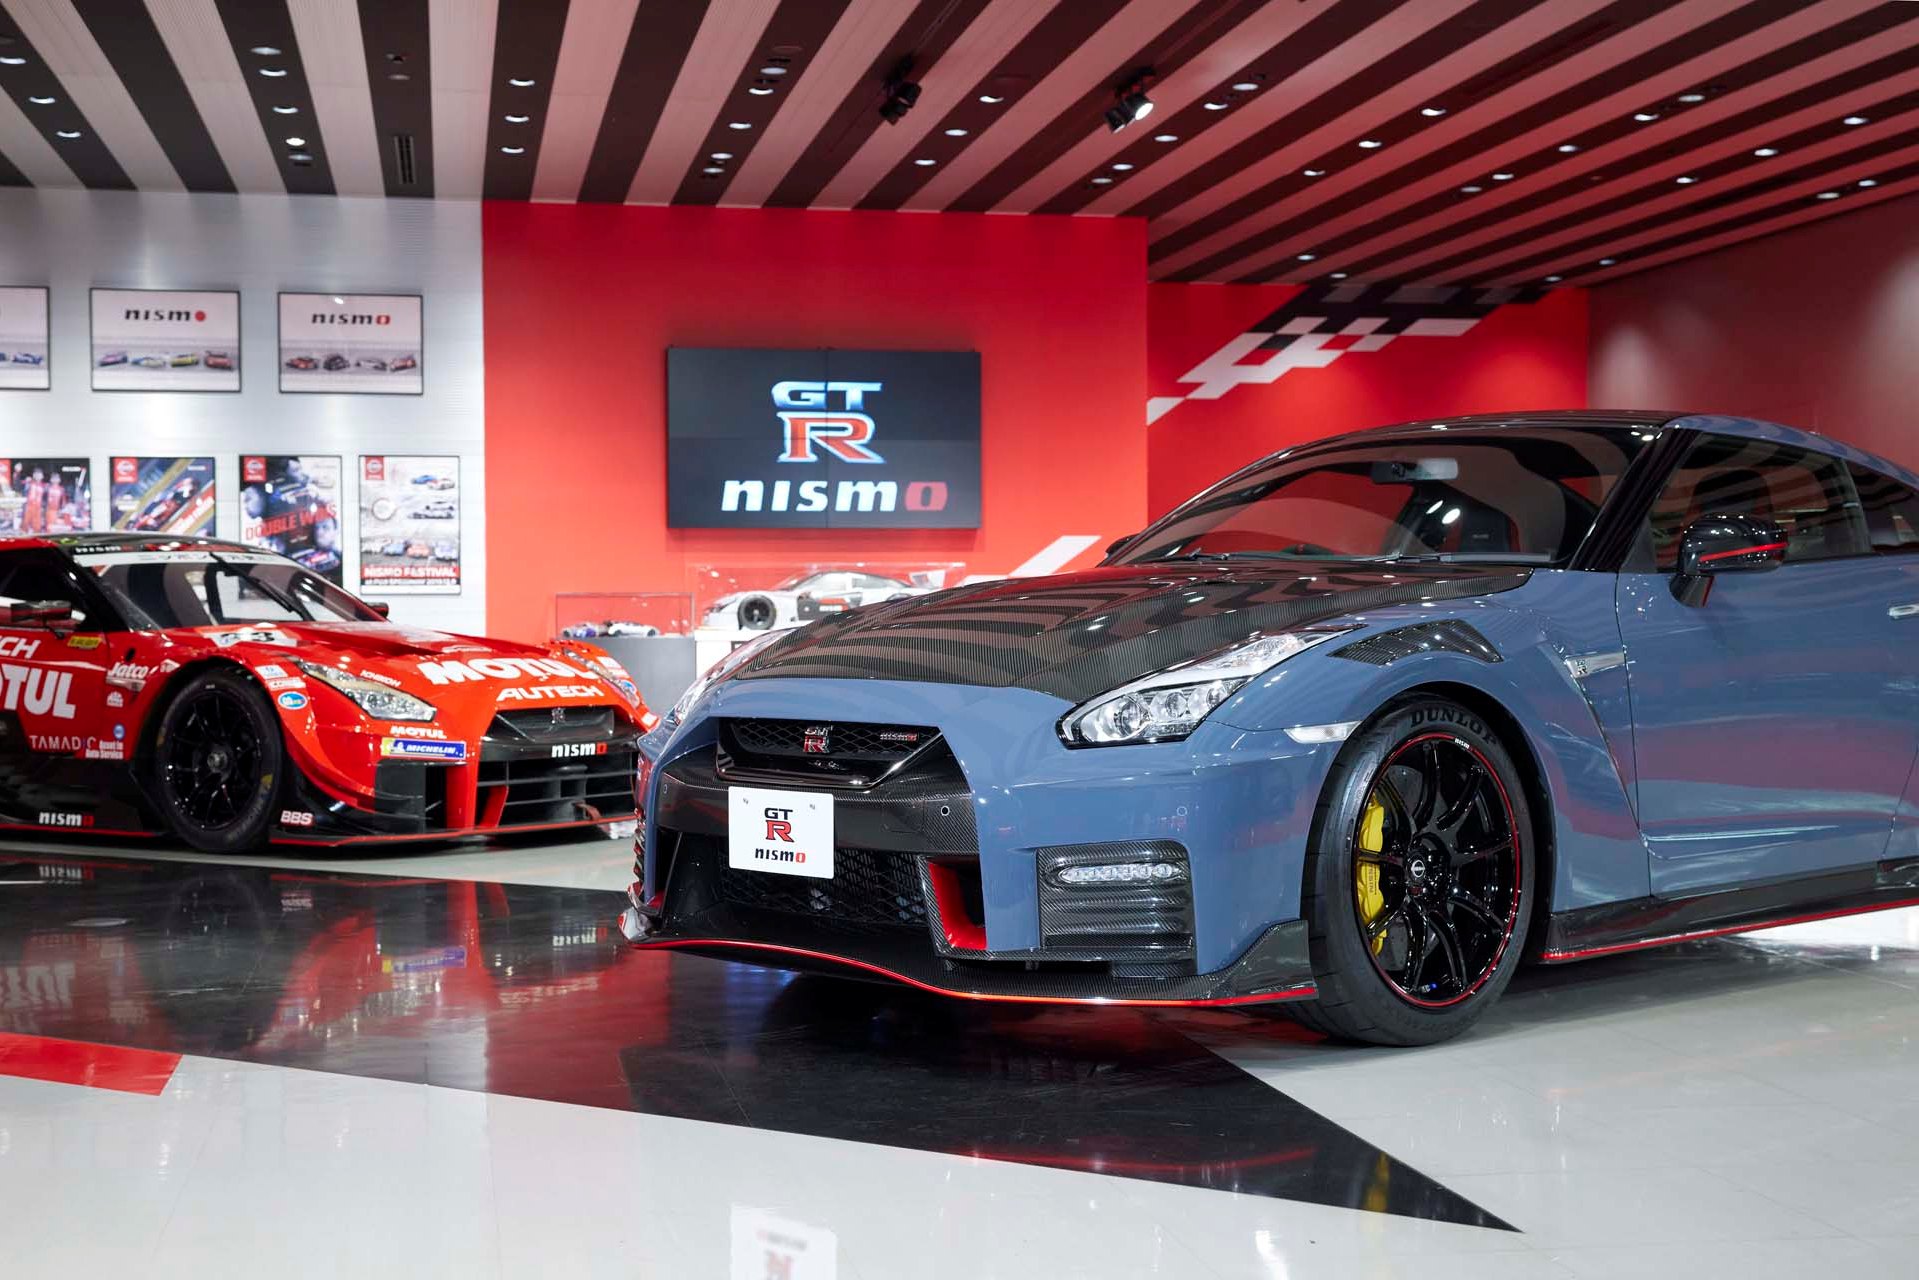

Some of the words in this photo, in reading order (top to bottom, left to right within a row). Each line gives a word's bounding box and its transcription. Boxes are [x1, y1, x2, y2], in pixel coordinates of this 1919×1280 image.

[311, 313, 391, 325] nismo
[771, 381, 883, 410] GT
[777, 411, 887, 464] R
[721, 480, 948, 512] nismo
[0, 636, 41, 659] CH
[416, 658, 599, 685] MOTUL
[0, 663, 76, 719] TUL
[496, 685, 604, 701] AUTECH
[390, 726, 447, 739] MOTUL
[1411, 708, 1498, 745] DUNLOP
[406, 745, 456, 754] MICHELIN
[39, 812, 94, 827] nismo
[280, 810, 313, 825] BBS
[764, 807, 793, 820] GT
[765, 819, 795, 843] R
[755, 848, 806, 863] nismo
